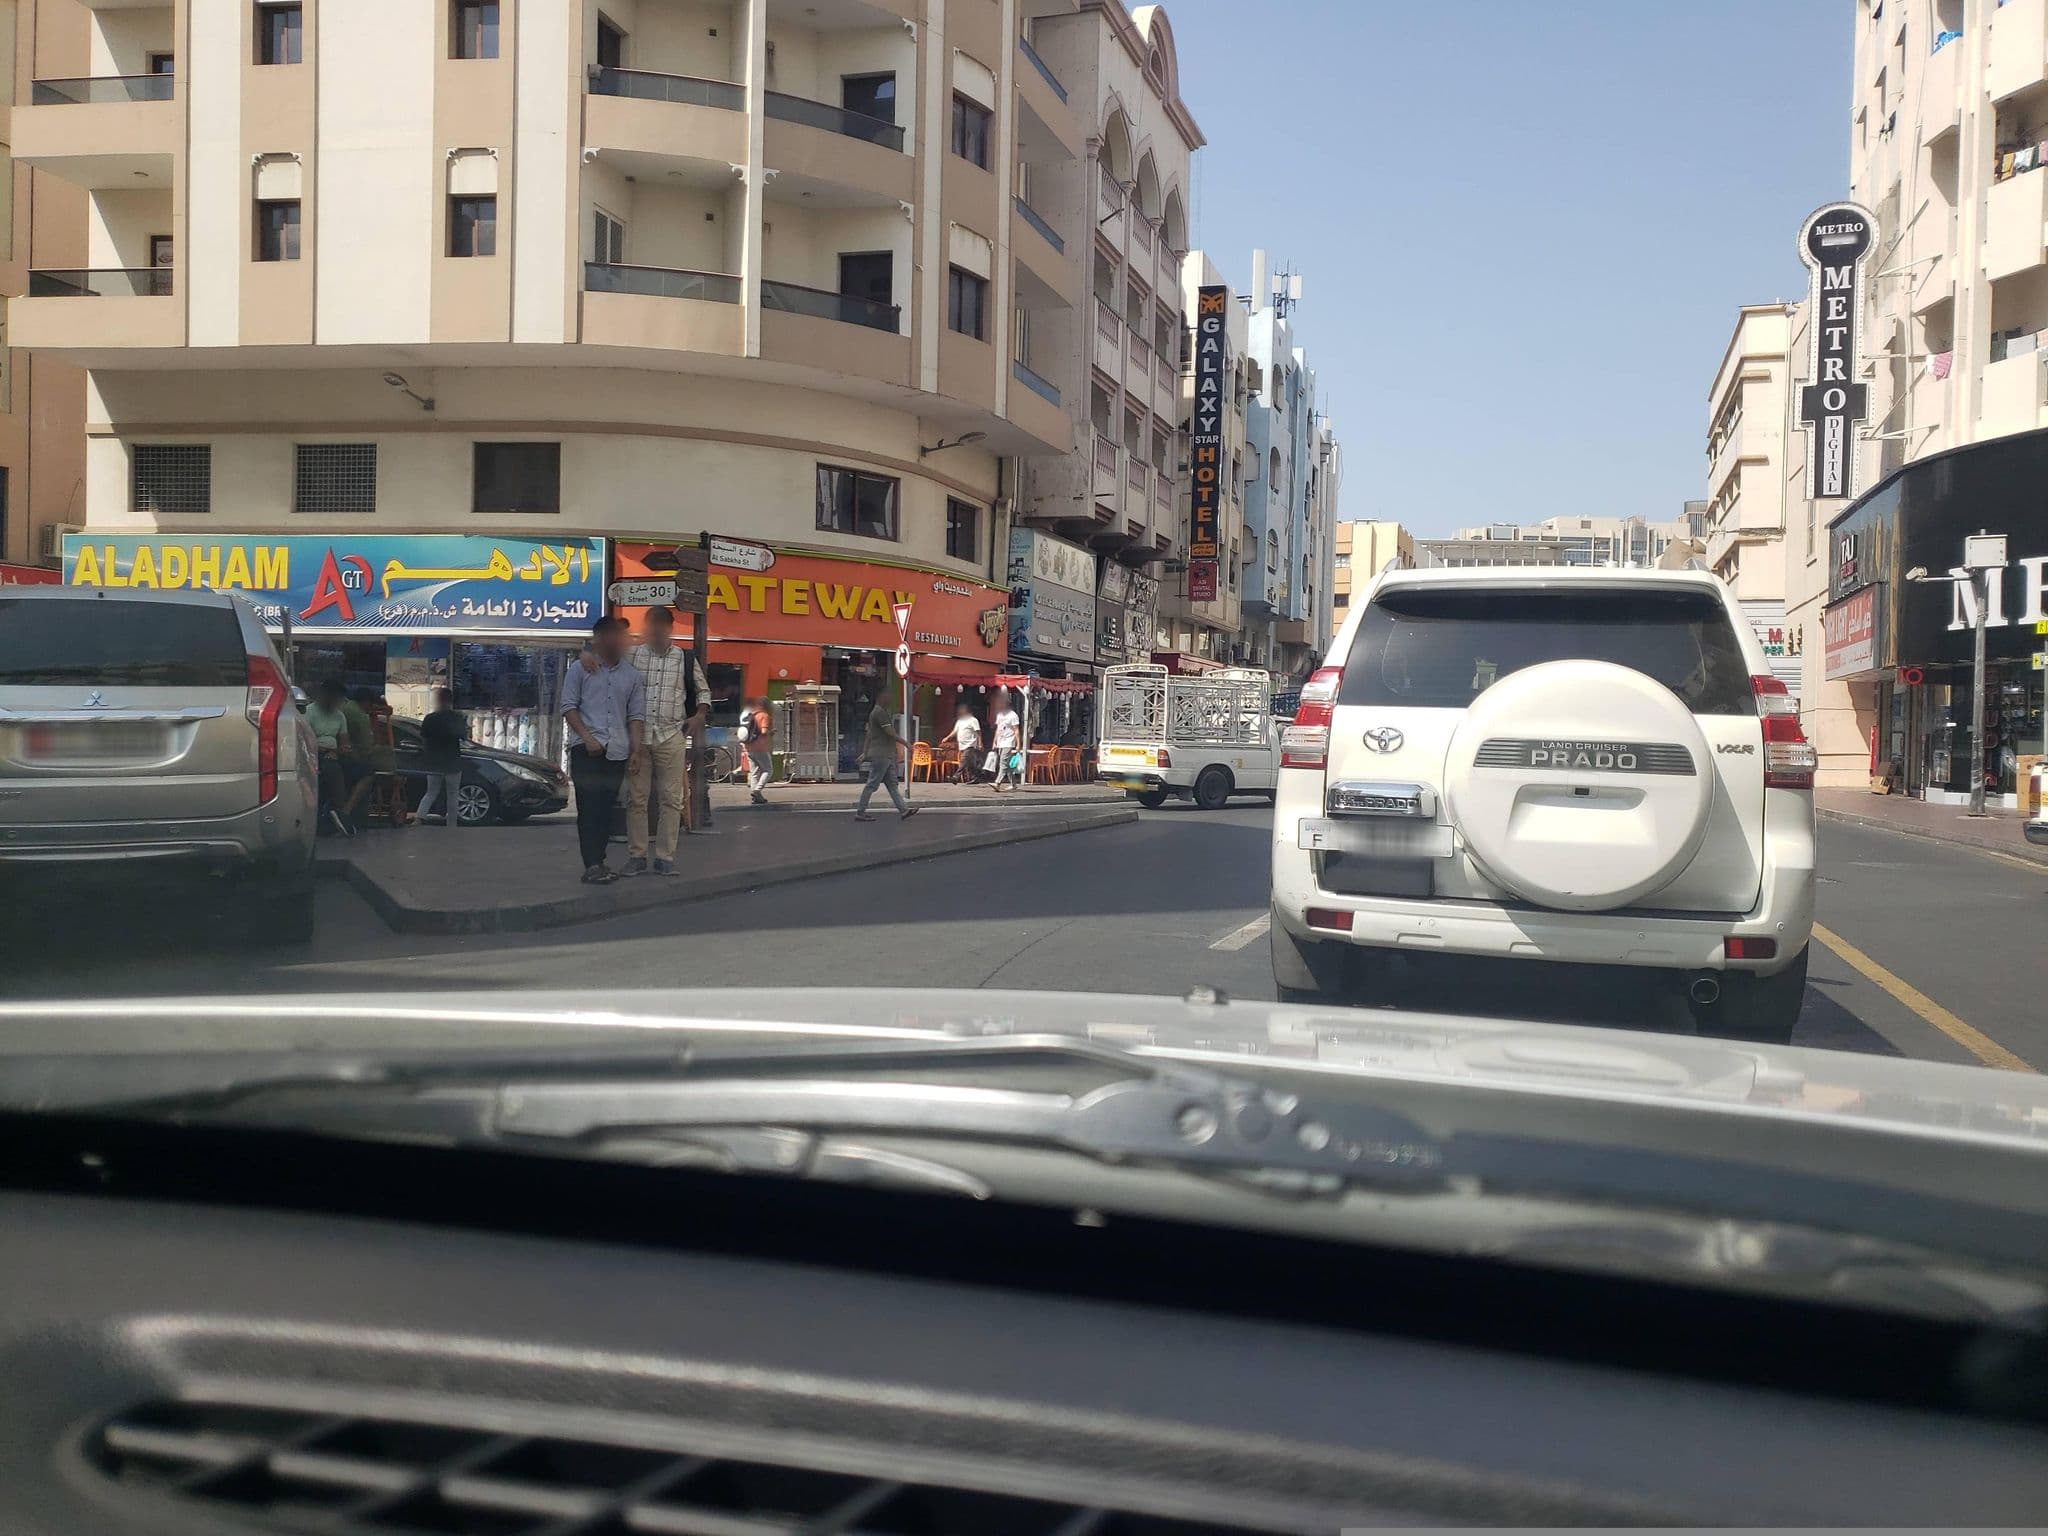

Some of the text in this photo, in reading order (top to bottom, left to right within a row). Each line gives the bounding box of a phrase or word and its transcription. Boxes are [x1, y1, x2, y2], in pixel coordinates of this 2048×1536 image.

[1816, 223, 1863, 235] METRO
[1823, 265, 1852, 411] METRO
[1200, 317, 1220, 432] GALAXY
[1195, 435, 1219, 444] STAR
[1828, 419, 1840, 492] DIGITAL
[1197, 447, 1215, 542] HOTEL
[71, 544, 289, 590] ALADHAM
[650, 586, 665, 598] 30
[462, 597, 516, 617] العامة
[522, 600, 589, 622] للتجارة
[915, 631, 961, 646] RESTAURANT
[1541, 741, 1628, 751] LAND CRUISER
[1531, 750, 1638, 769] PRADO
[1312, 834, 1323, 847] F
